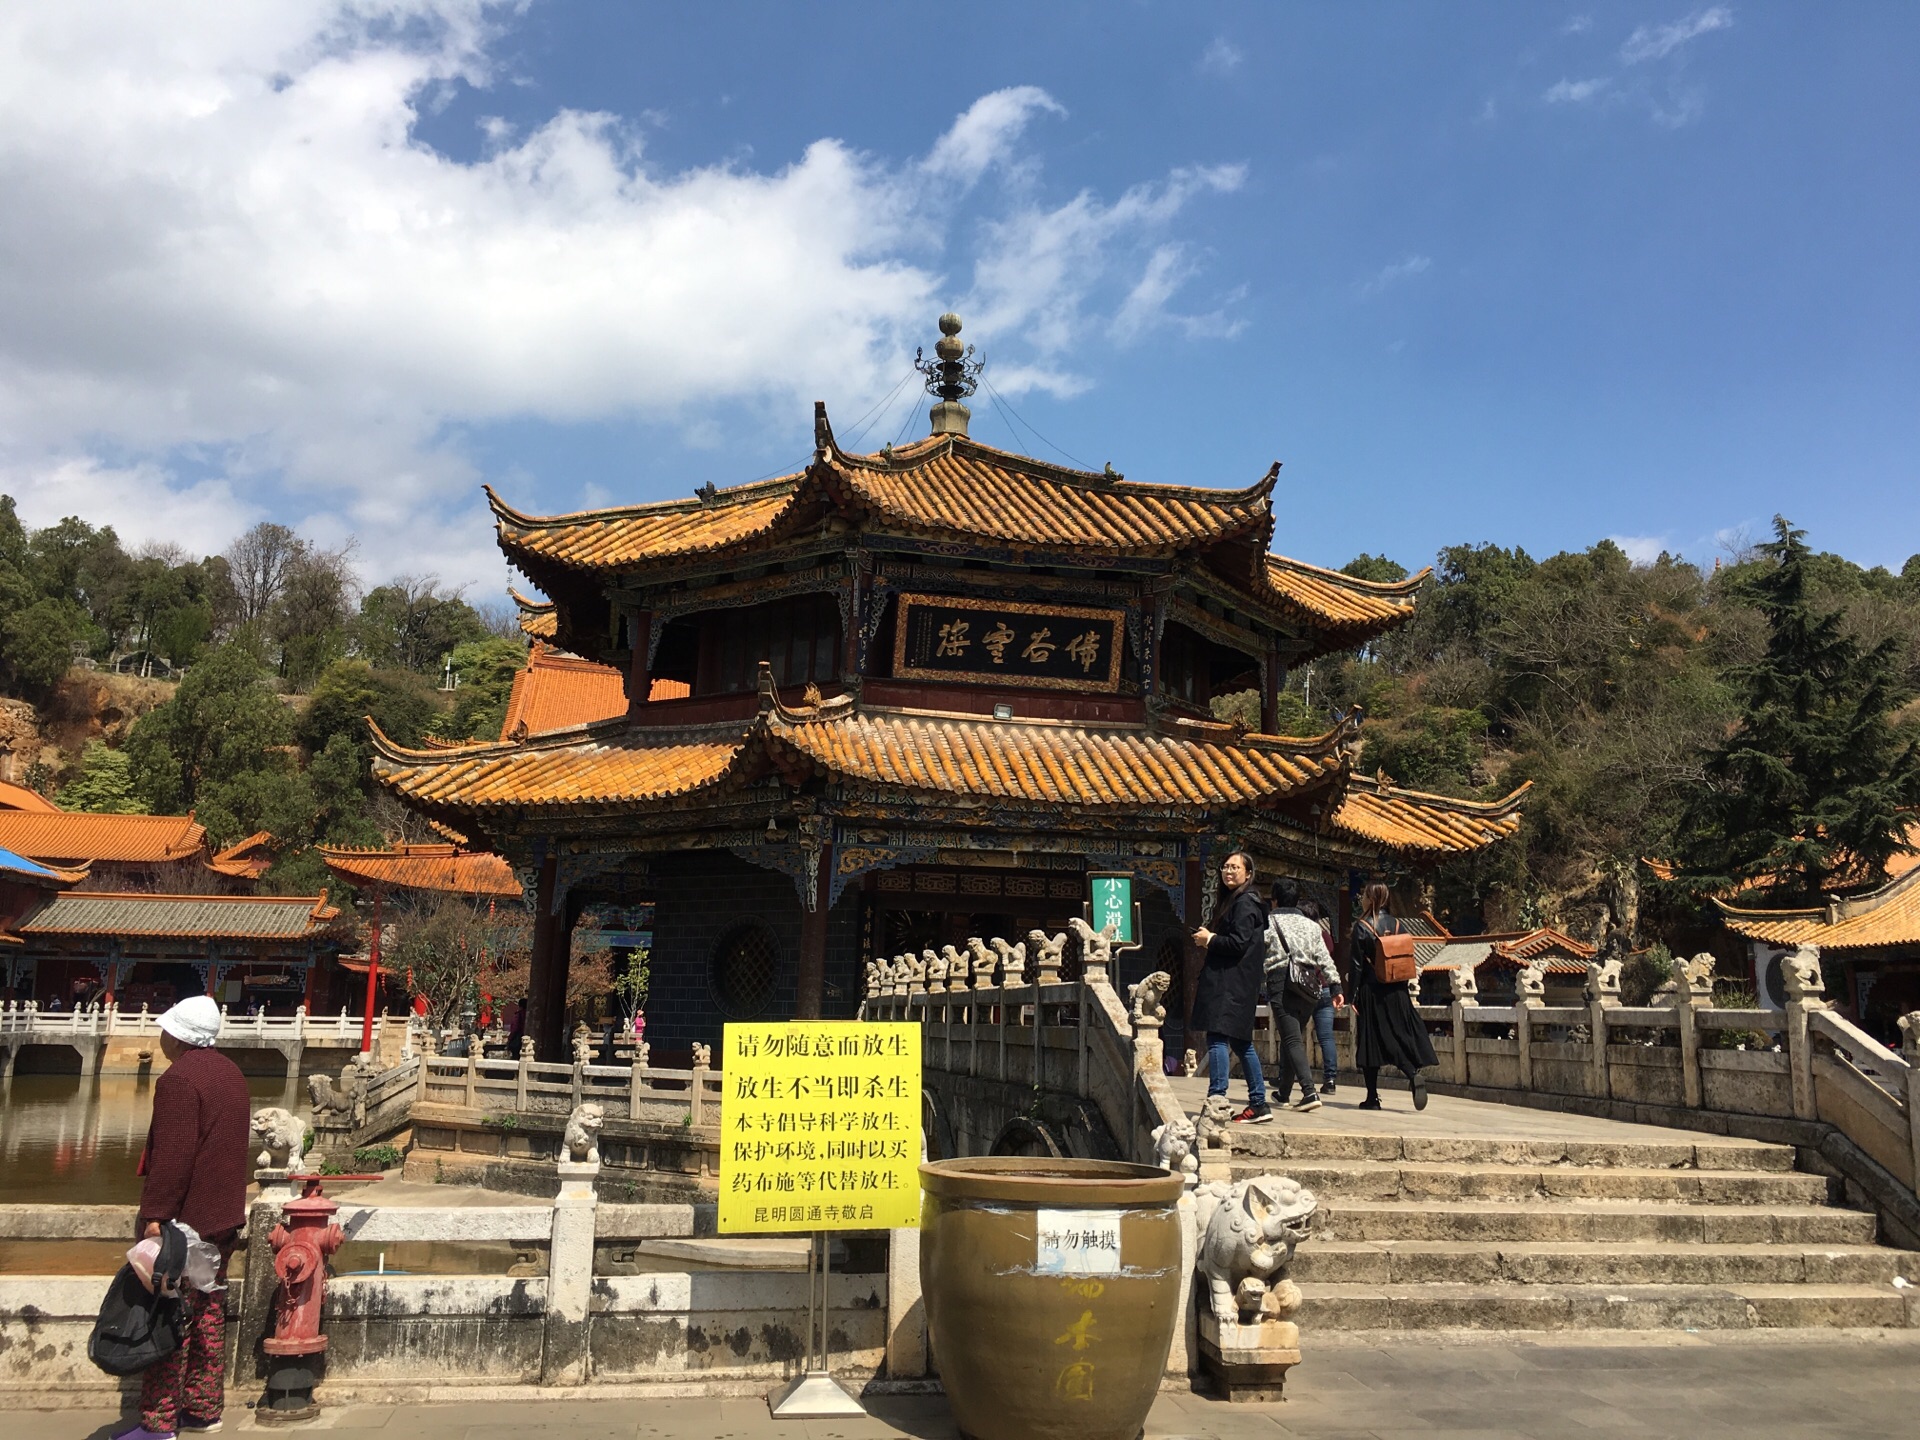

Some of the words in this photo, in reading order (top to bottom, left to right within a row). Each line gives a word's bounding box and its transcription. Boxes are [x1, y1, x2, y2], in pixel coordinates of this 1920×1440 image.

[736, 1034, 909, 1057] 请勿随意而放生
[735, 1075, 909, 1099] 放生不当即杀生
[732, 1170, 909, 1193] 药布施等代替放生。
[754, 1204, 874, 1223] 昆明圆通寺敬启
